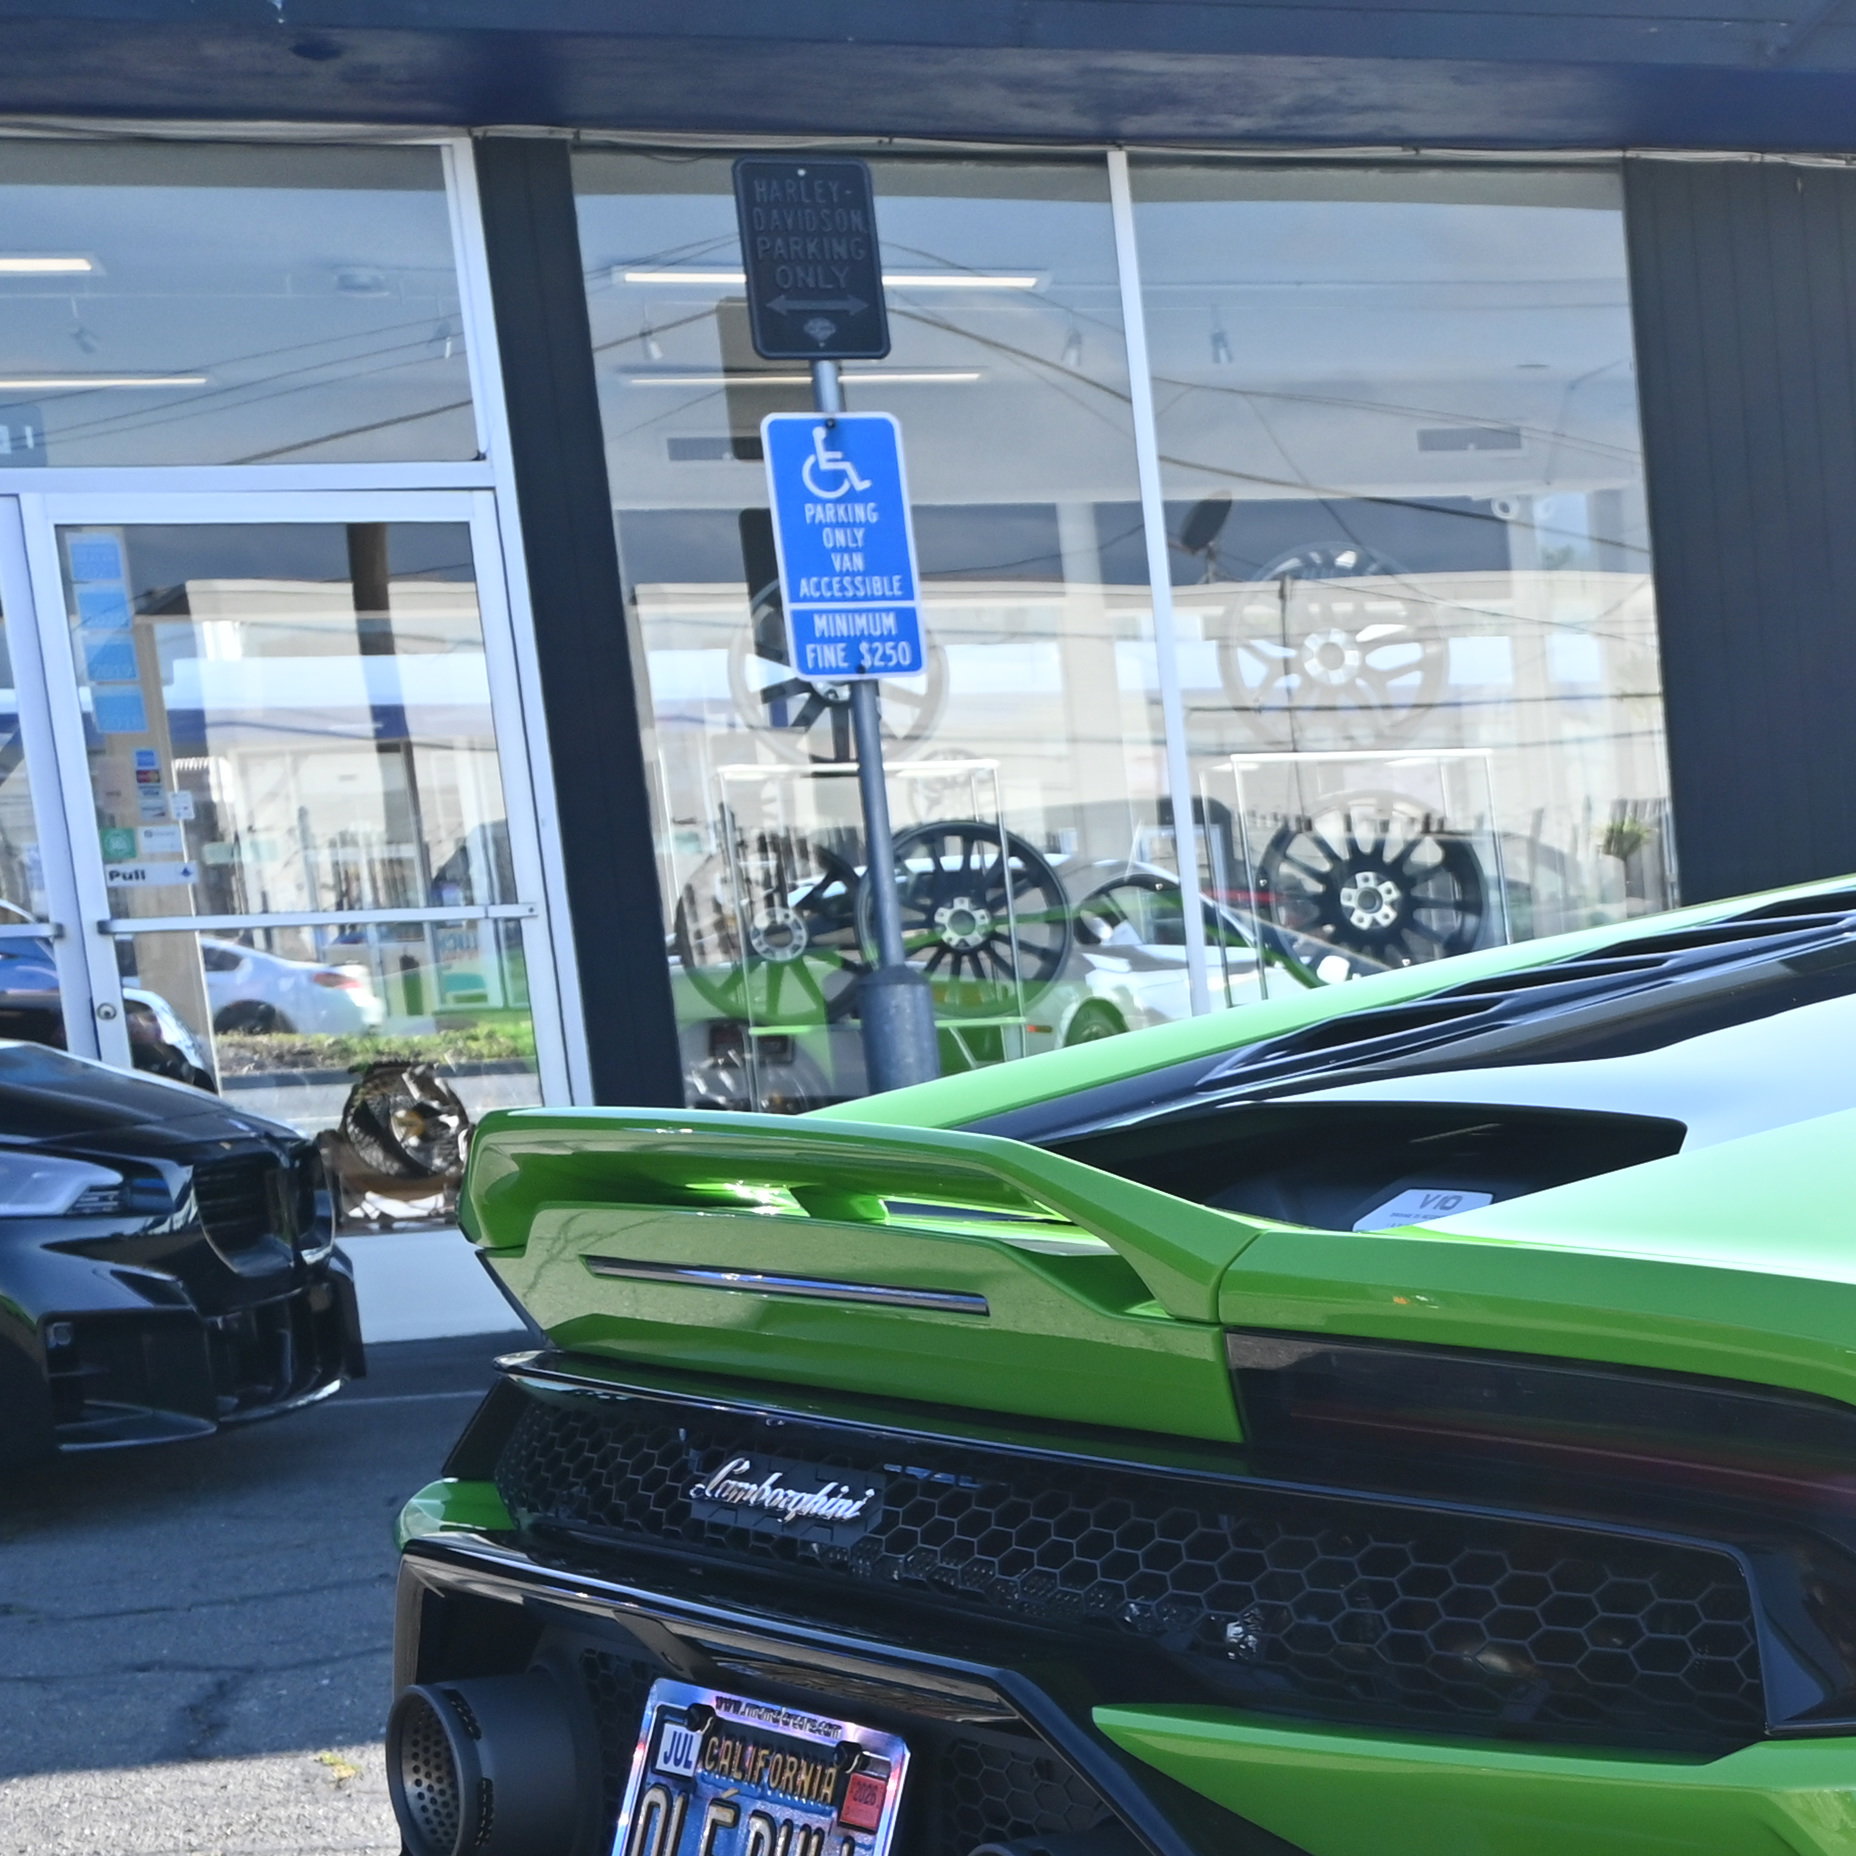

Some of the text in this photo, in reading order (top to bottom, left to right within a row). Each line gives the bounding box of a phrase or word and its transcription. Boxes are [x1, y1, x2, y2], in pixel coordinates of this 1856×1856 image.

[753, 207, 866, 233] DAVIDSON
[756, 236, 866, 261] PARKING
[775, 265, 850, 289] ONLY
[804, 502, 878, 525] PARKING
[823, 527, 865, 549] ONLY
[831, 552, 864, 573] VAN
[799, 574, 903, 600] ACCESSIBLE
[813, 612, 897, 638] MINIMUM
[806, 640, 912, 670] FINE $250
[108, 869, 146, 882] Pull
[1419, 1193, 1464, 1211] V10
[689, 1457, 875, 1524] Lamborghini
[663, 1729, 694, 1768] JUL
[704, 1737, 838, 1803] CALIFORNIA
